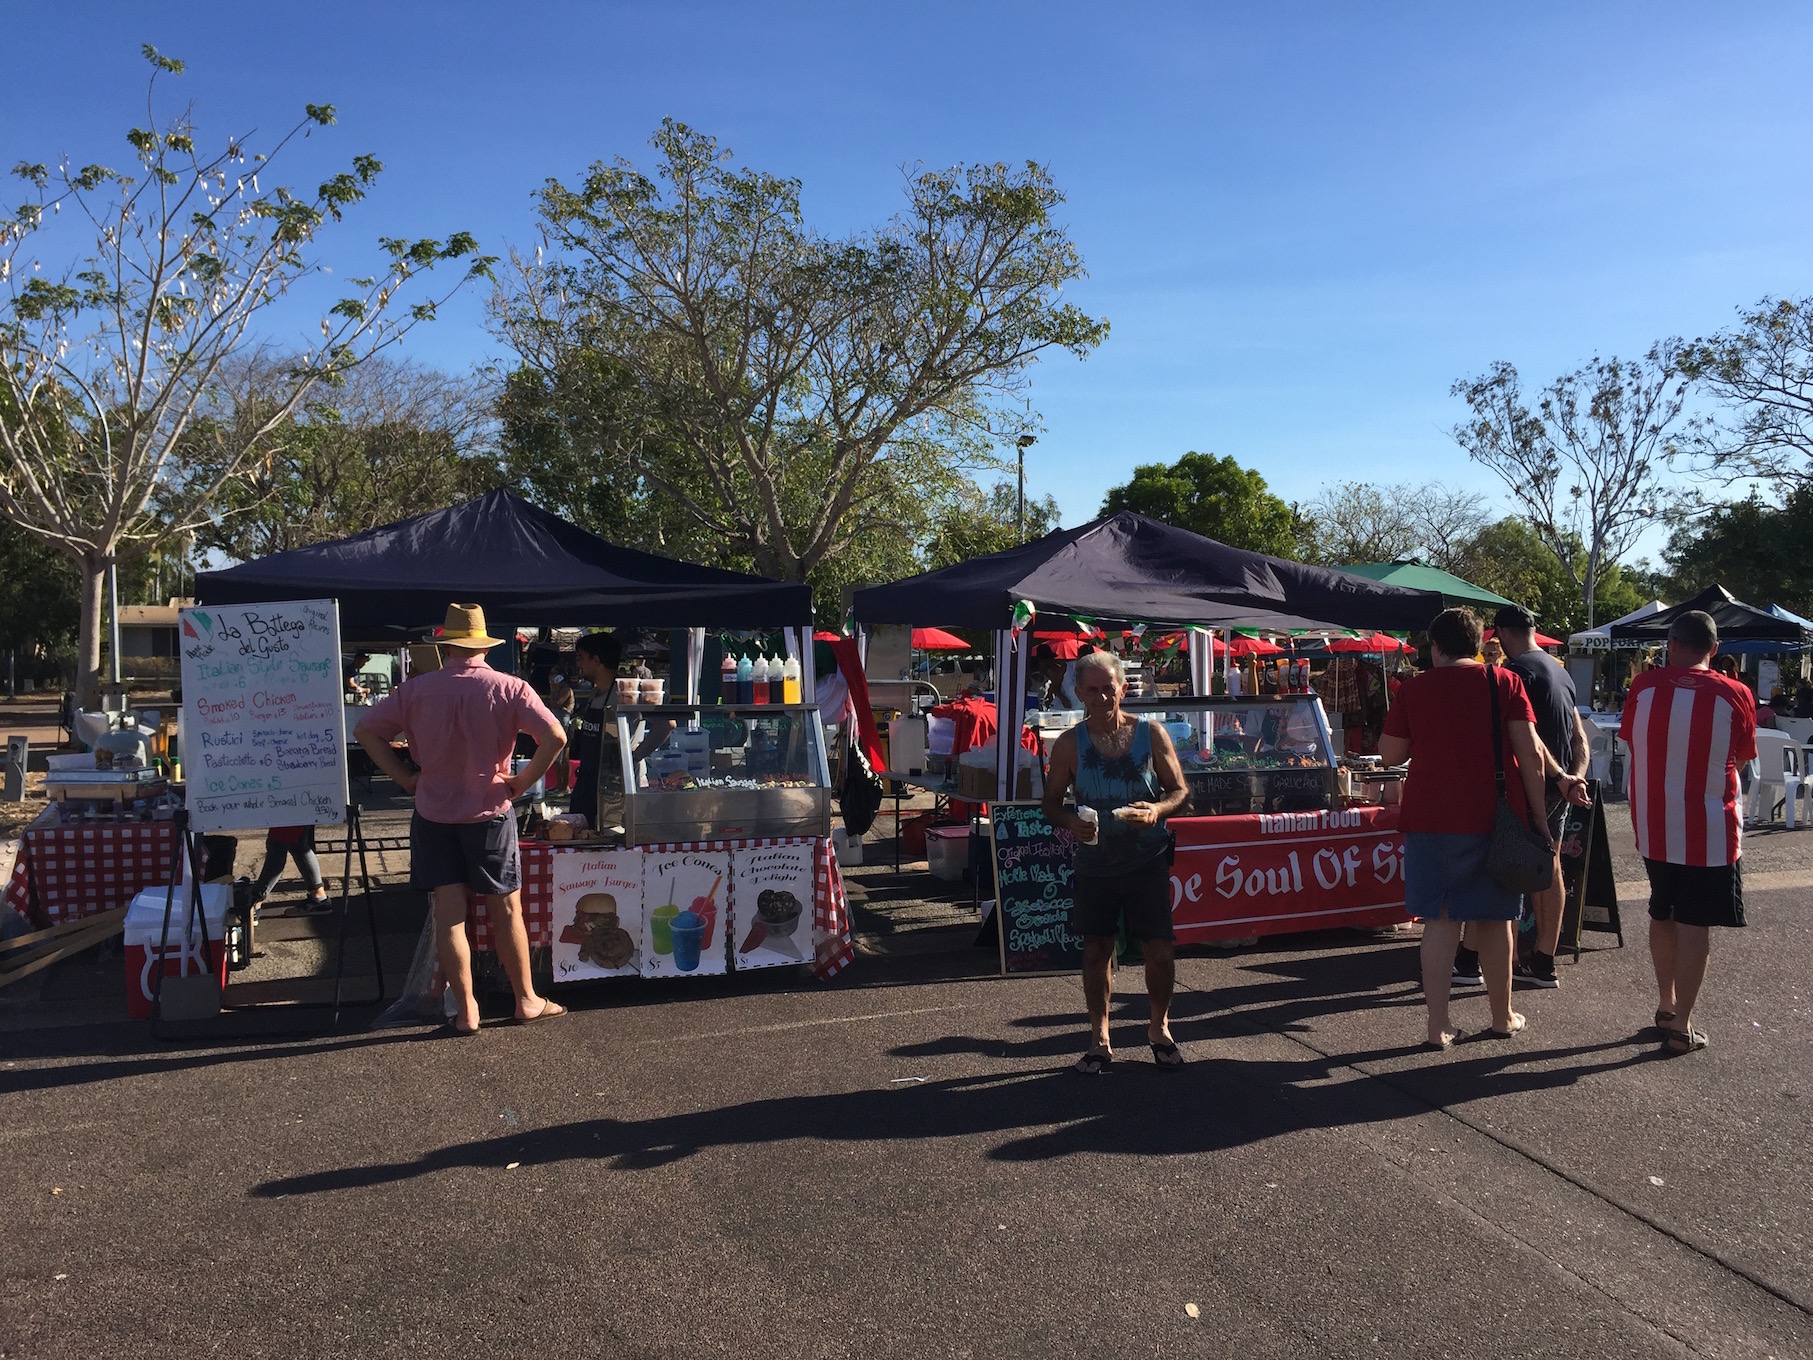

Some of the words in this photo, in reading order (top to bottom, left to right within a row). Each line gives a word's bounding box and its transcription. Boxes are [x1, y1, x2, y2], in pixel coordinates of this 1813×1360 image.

[217, 613, 241, 641] La
[241, 612, 305, 639] Bottega
[239, 638, 256, 656] del
[252, 636, 290, 659] Gusto
[196, 660, 243, 681] Italian
[247, 653, 283, 678] Style
[289, 650, 332, 679] Sausage
[197, 693, 246, 716] Smoked
[253, 690, 297, 709] Chicken
[202, 731, 243, 749] Rustici
[309, 742, 337, 755] Bread
[204, 777, 226, 792] Ice
[696, 777, 724, 787] Italian
[725, 775, 758, 790] Sausage
[196, 800, 219, 813] Book
[221, 802, 241, 815] your
[300, 790, 332, 806] Chicken
[993, 806, 1046, 824] Experienc
[1258, 813, 1319, 834] Italian
[1014, 819, 1053, 838] Taste
[581, 861, 617, 873] Italian
[652, 860, 679, 877] Ice
[682, 856, 722, 876] Cones
[748, 852, 801, 866] Italian
[740, 863, 807, 878] Chocolate
[750, 874, 797, 885] Delight
[1215, 850, 1303, 899] Soul
[1313, 845, 1362, 890] Of
[558, 880, 597, 895] Sausage
[604, 876, 637, 889] Burger
[559, 959, 578, 977] $10
[648, 957, 661, 971] $5
